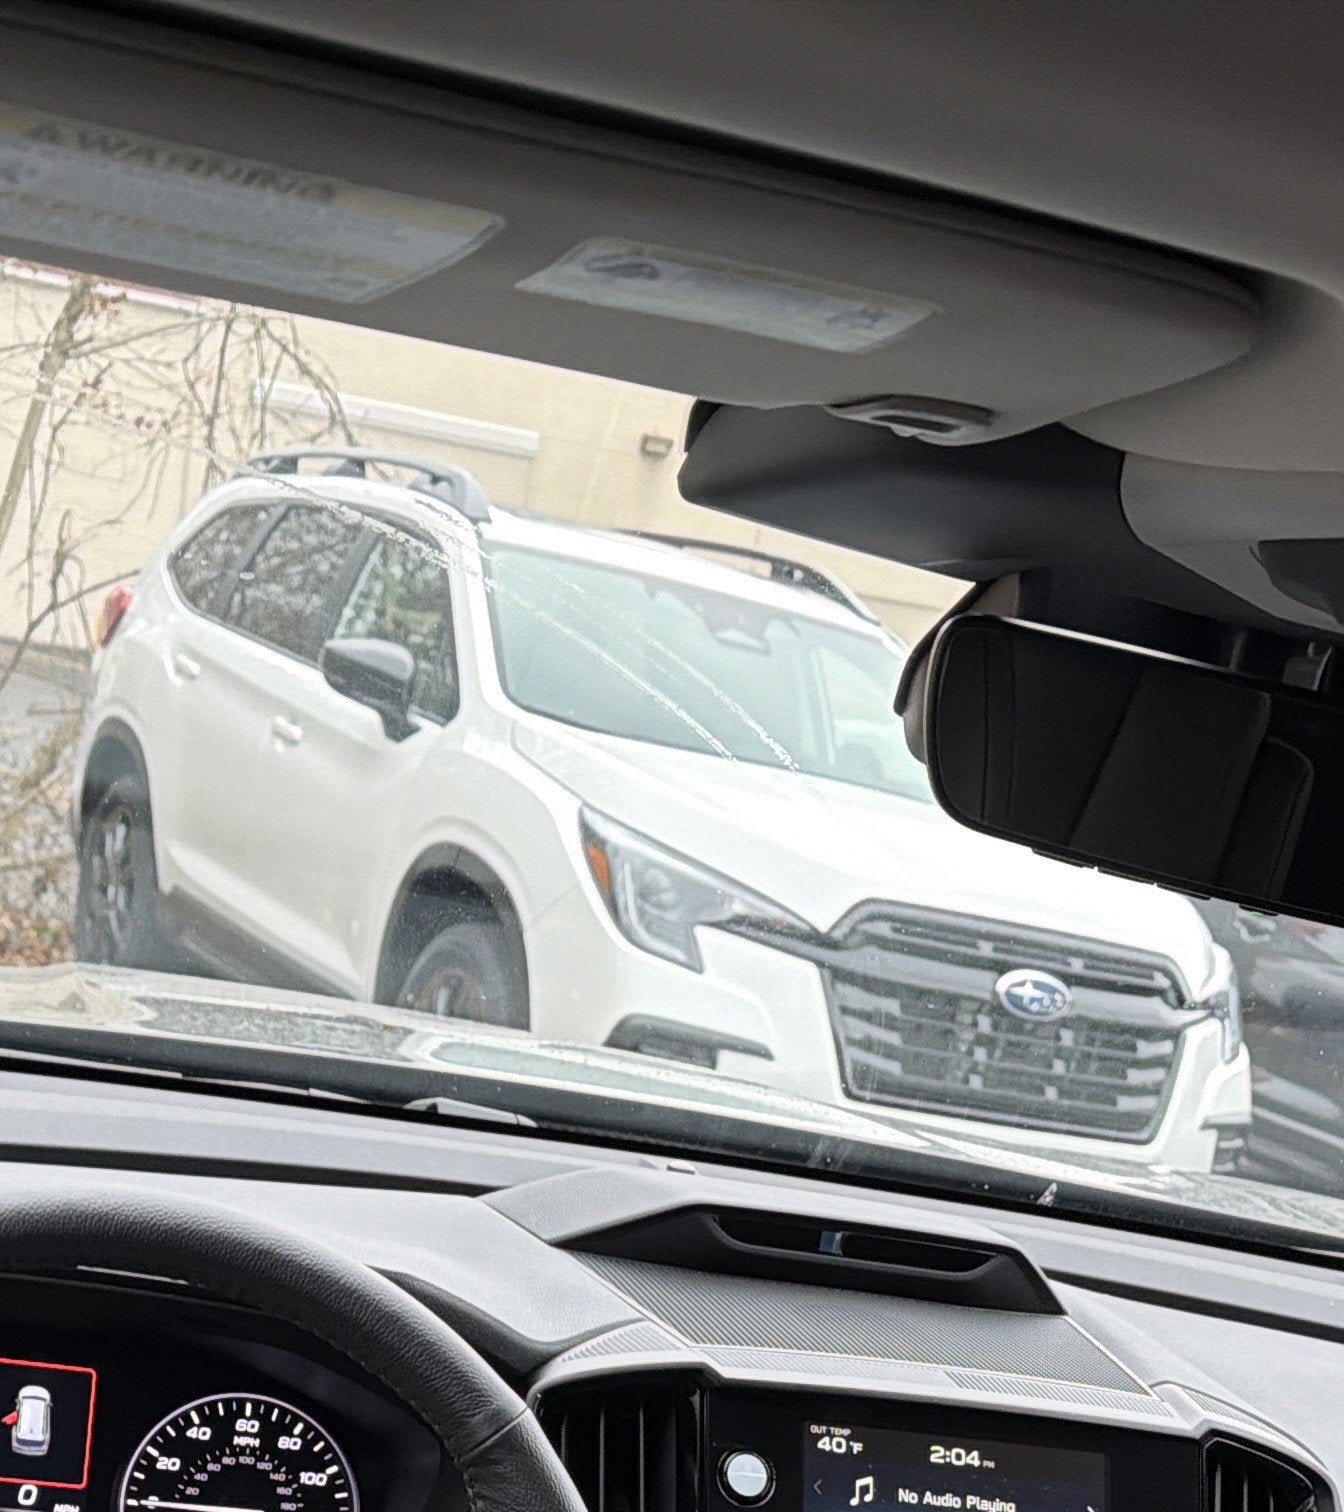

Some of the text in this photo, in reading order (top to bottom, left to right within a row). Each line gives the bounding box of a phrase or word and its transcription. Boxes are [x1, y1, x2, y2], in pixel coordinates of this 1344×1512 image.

[186, 1426, 212, 1441] 40
[235, 1418, 260, 1433] 60
[810, 1424, 851, 1436] OUT TEMP
[233, 1435, 260, 1448] MPH
[277, 1435, 302, 1451] 80
[817, 1436, 846, 1454] 40
[156, 1456, 181, 1471] 20
[929, 1445, 981, 1467] 2:04
[299, 1471, 328, 1487] 100
[17, 1484, 38, 1506] 0
[898, 1488, 918, 1505] No
[923, 1491, 962, 1509] Audio
